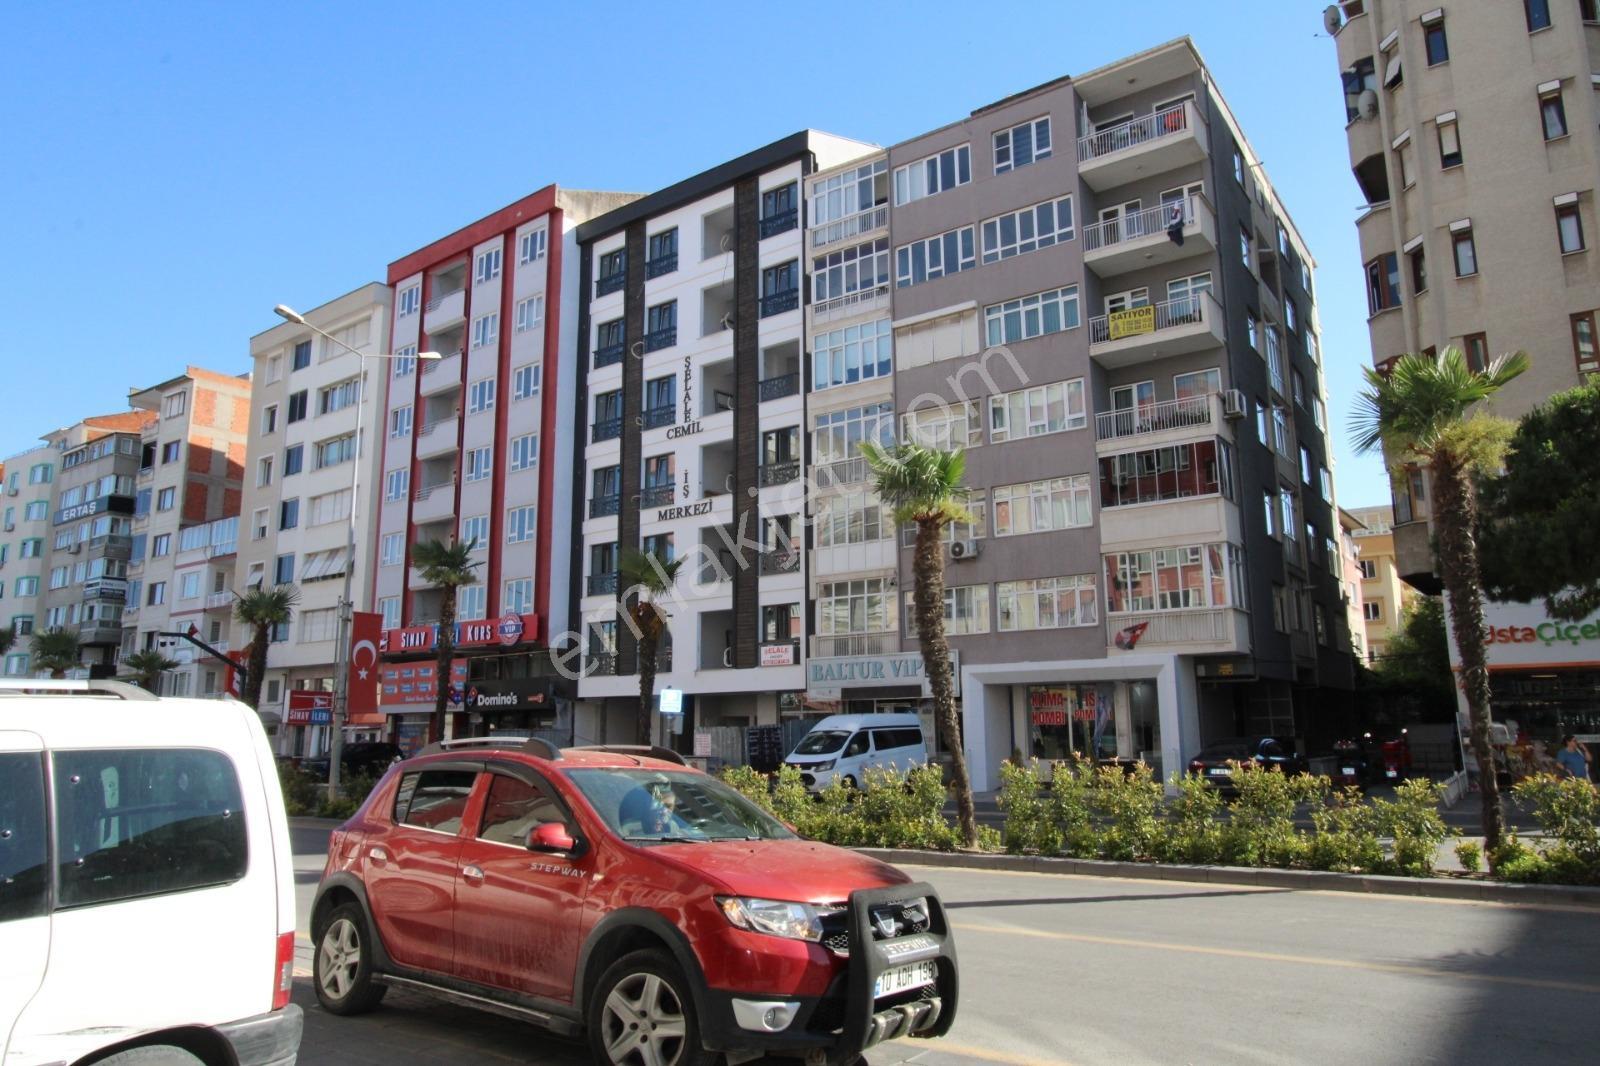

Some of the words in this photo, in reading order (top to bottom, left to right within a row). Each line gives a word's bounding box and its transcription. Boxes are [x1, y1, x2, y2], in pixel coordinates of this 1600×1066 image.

[1110, 308, 1152, 322] SATIYOR
[666, 421, 704, 440] CEMİL
[63, 502, 96, 521] ERTAŞ
[657, 499, 713, 522] MERKEZİ
[467, 624, 492, 642] KURS
[812, 662, 886, 681] BALTUR
[477, 692, 518, 706] Domino's
[530, 862, 586, 878] STEPWAY
